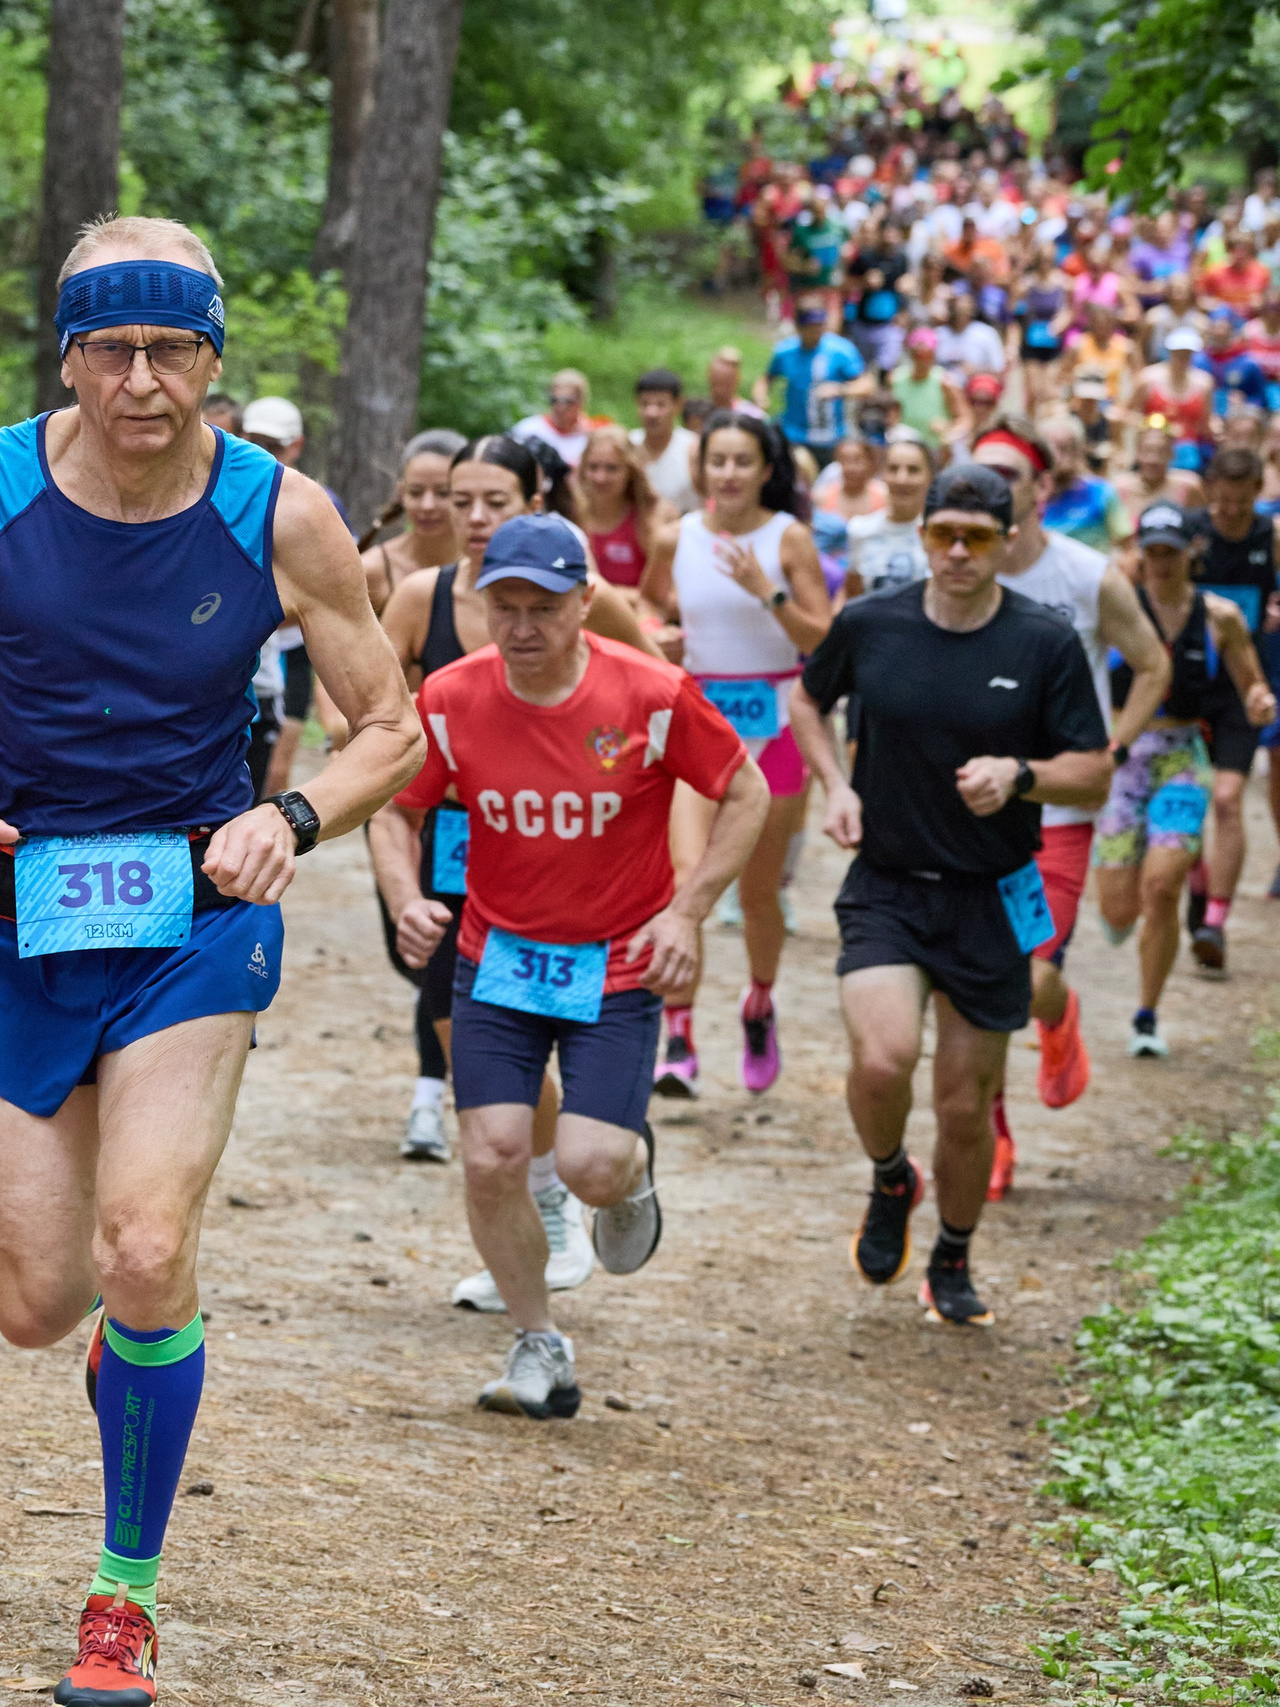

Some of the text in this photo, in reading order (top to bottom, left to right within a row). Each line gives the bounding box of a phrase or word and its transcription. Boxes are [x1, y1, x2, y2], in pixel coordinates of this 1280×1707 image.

[714, 698, 765, 720] 40
[57, 860, 153, 908] 318
[85, 923, 133, 938] 12 KM
[512, 947, 576, 988] 313
